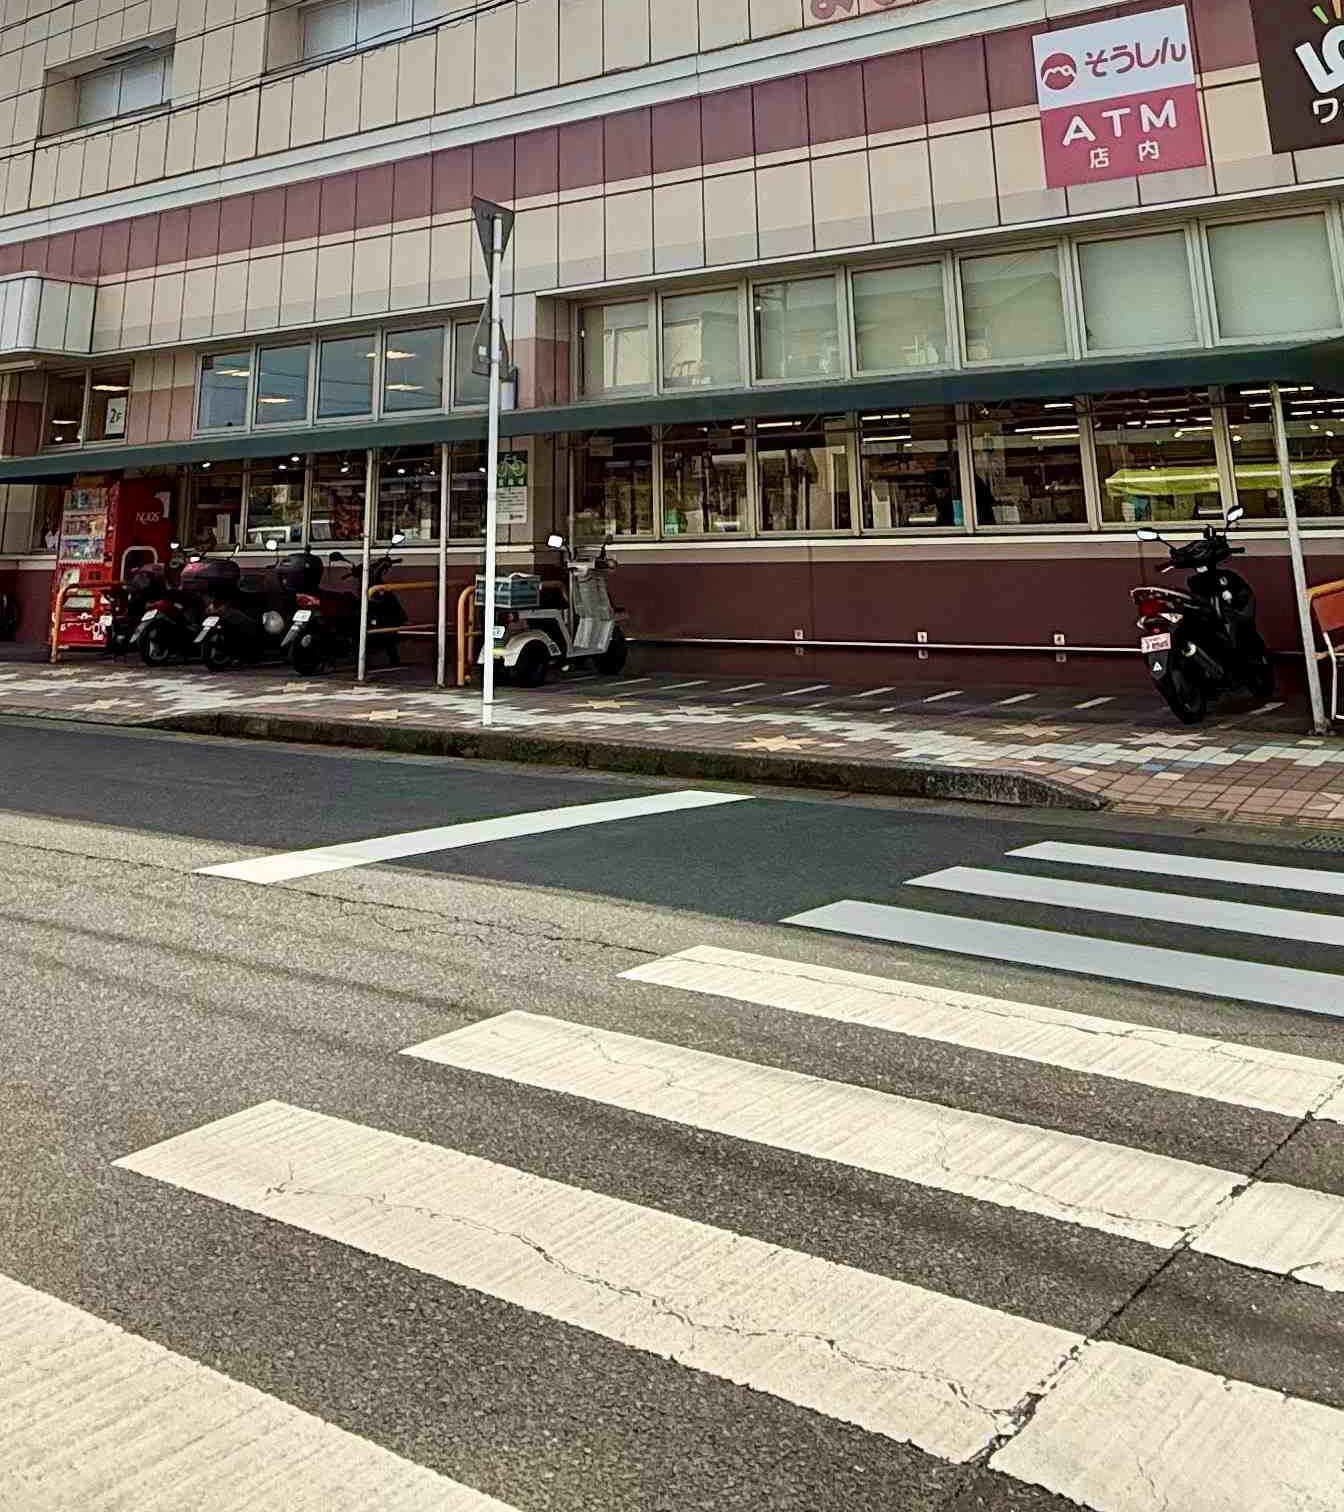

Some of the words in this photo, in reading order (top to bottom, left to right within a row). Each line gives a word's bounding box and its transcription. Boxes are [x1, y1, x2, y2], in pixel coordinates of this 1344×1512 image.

[1083, 35, 1187, 79] そうしん
[1062, 98, 1177, 147] ATM
[109, 407, 122, 424] 2F
